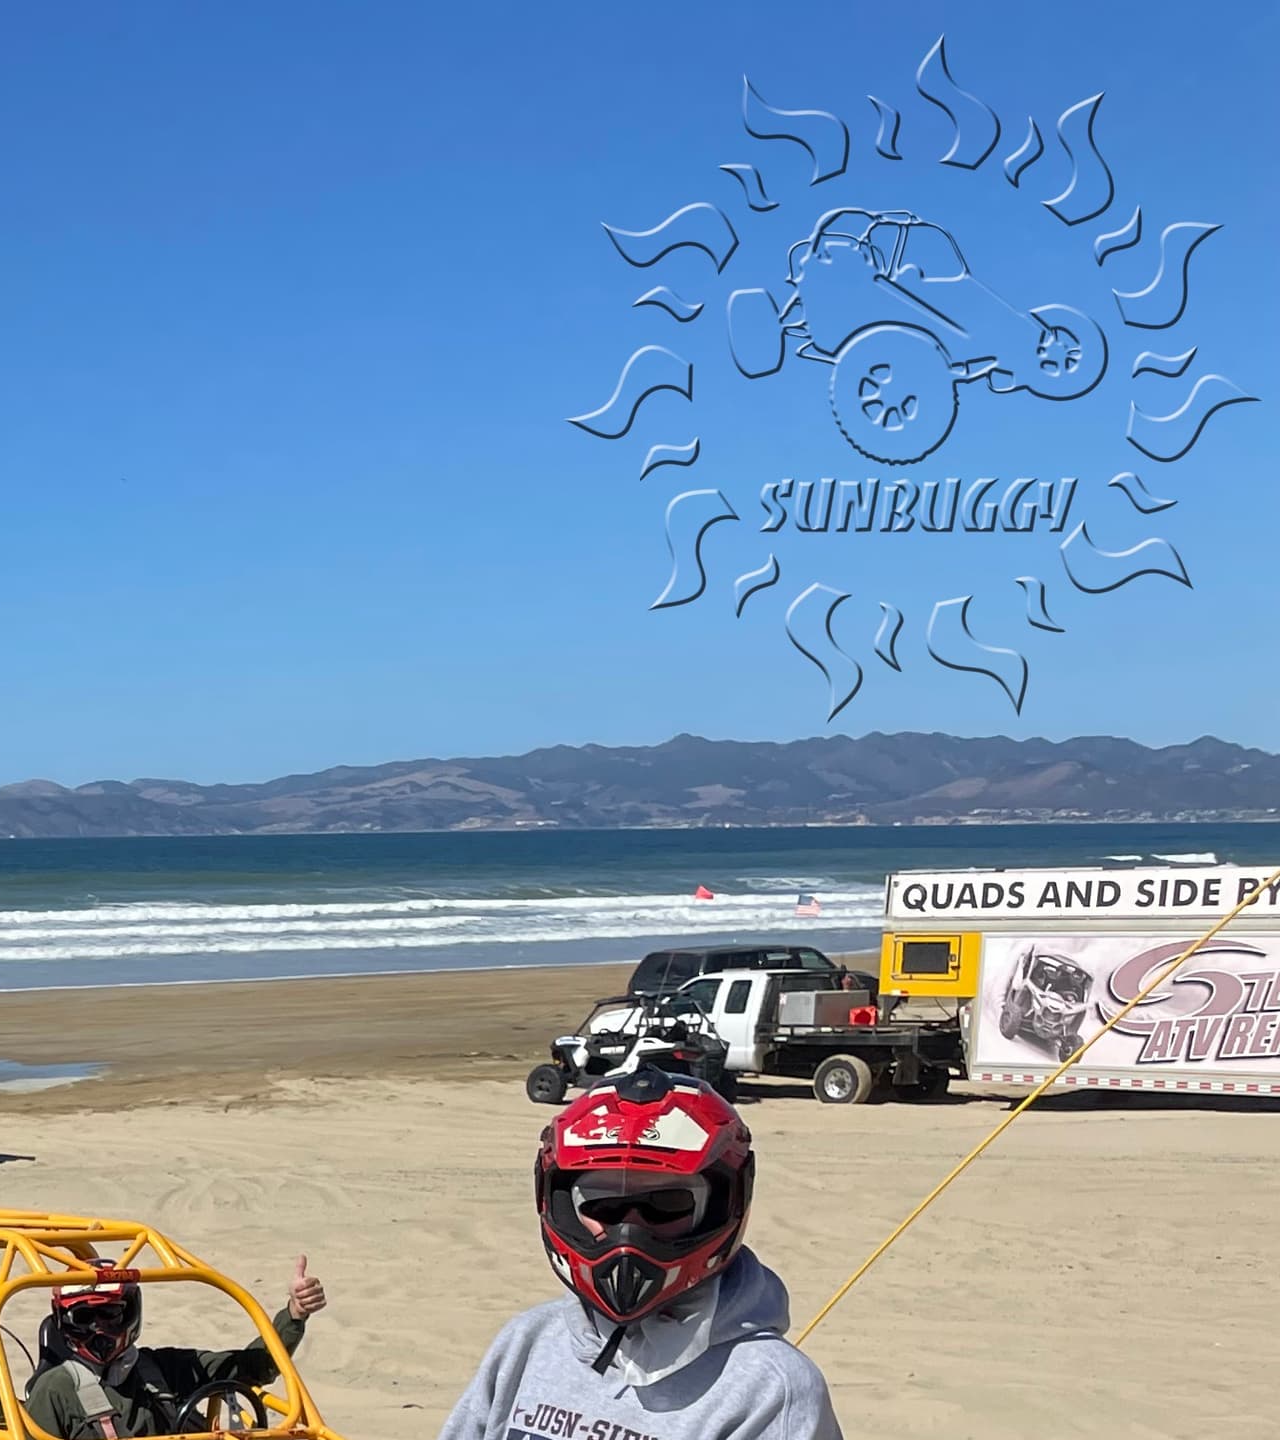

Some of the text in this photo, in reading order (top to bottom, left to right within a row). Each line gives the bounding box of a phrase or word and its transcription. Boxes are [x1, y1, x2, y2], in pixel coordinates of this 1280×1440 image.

[902, 881, 1025, 912] QUADS
[1037, 879, 1122, 908] AND
[1135, 878, 1222, 907] SIDE
[1137, 1014, 1280, 1064] ATV RE
